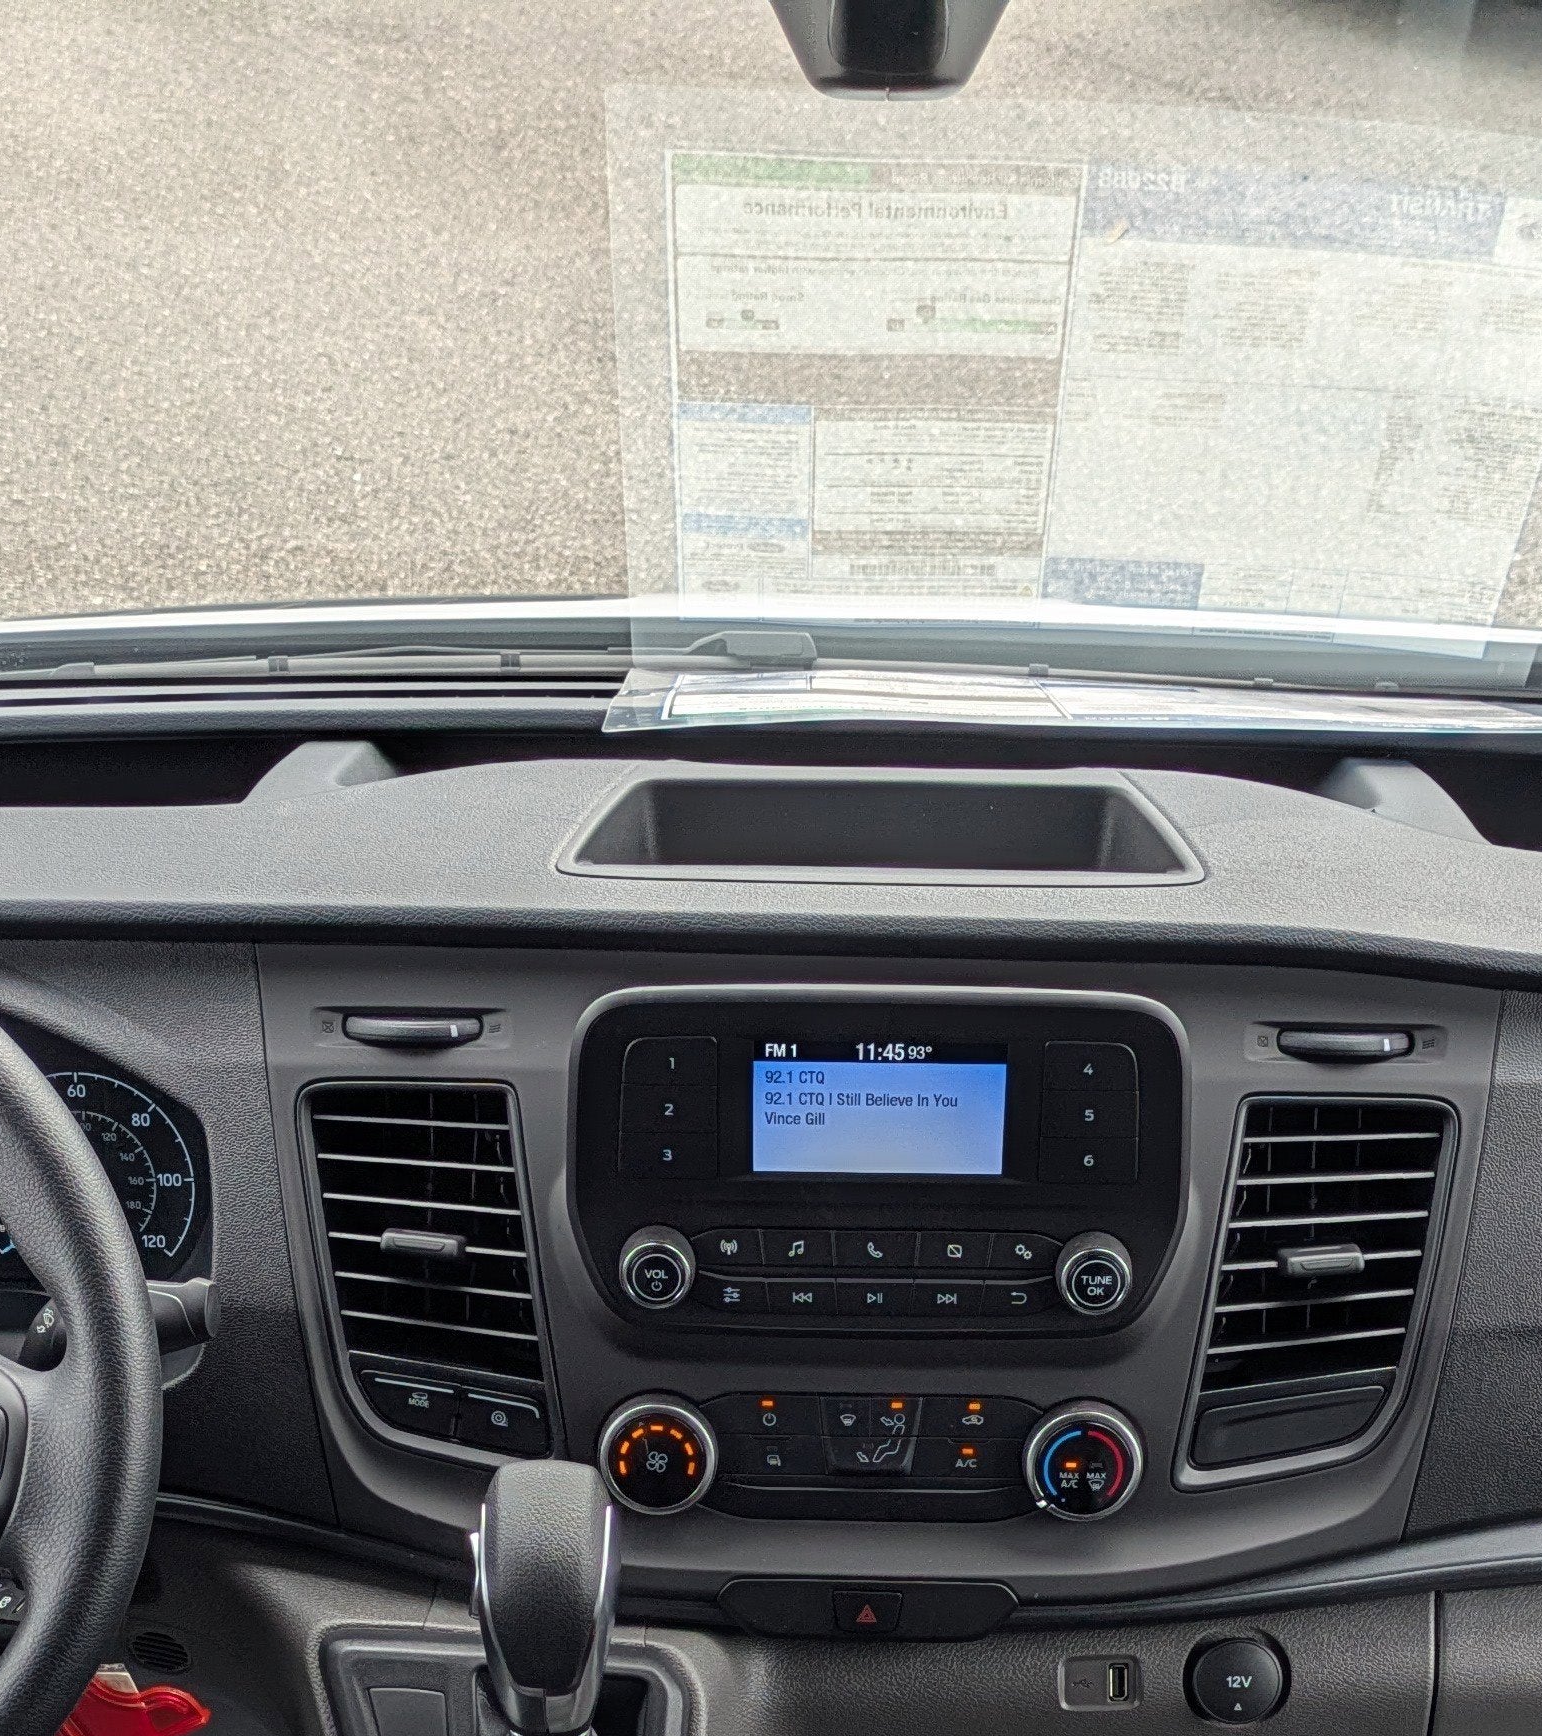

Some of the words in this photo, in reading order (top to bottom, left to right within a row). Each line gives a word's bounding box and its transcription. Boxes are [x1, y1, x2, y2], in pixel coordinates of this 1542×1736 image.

[765, 1043, 786, 1058] FM
[790, 1044, 797, 1058] 1
[856, 1043, 905, 1061] 11:45
[668, 1057, 675, 1070] 1
[1083, 1063, 1094, 1075] 4
[765, 1070, 793, 1084] 92.1
[799, 1071, 825, 1085] CTQ
[67, 1084, 86, 1098] 60
[765, 1092, 793, 1106] 92.1
[799, 1092, 825, 1106] CTQ
[837, 1093, 861, 1107] Still
[865, 1093, 913, 1107] Believe
[917, 1093, 929, 1107] In
[933, 1094, 958, 1107] You
[664, 1103, 674, 1116] 2
[1084, 1109, 1094, 1122] 5
[131, 1113, 150, 1127] 80
[765, 1112, 801, 1125] Vince
[805, 1112, 825, 1125] Gill
[101, 1133, 117, 1142] 120
[119, 1153, 135, 1162] 140
[662, 1149, 673, 1161] 3
[1084, 1155, 1094, 1167] 6
[128, 1176, 144, 1186] 160
[157, 1173, 182, 1187] 100
[126, 1201, 141, 1210] 180
[142, 1235, 166, 1248] 120
[644, 1269, 669, 1280] VOL
[1081, 1275, 1113, 1287] TUNE
[1087, 1286, 1104, 1297] OK
[408, 1397, 430, 1409] MODE
[955, 1457, 977, 1469] A/C
[1061, 1480, 1078, 1488] A/C
[1226, 1676, 1252, 1689] 12V
